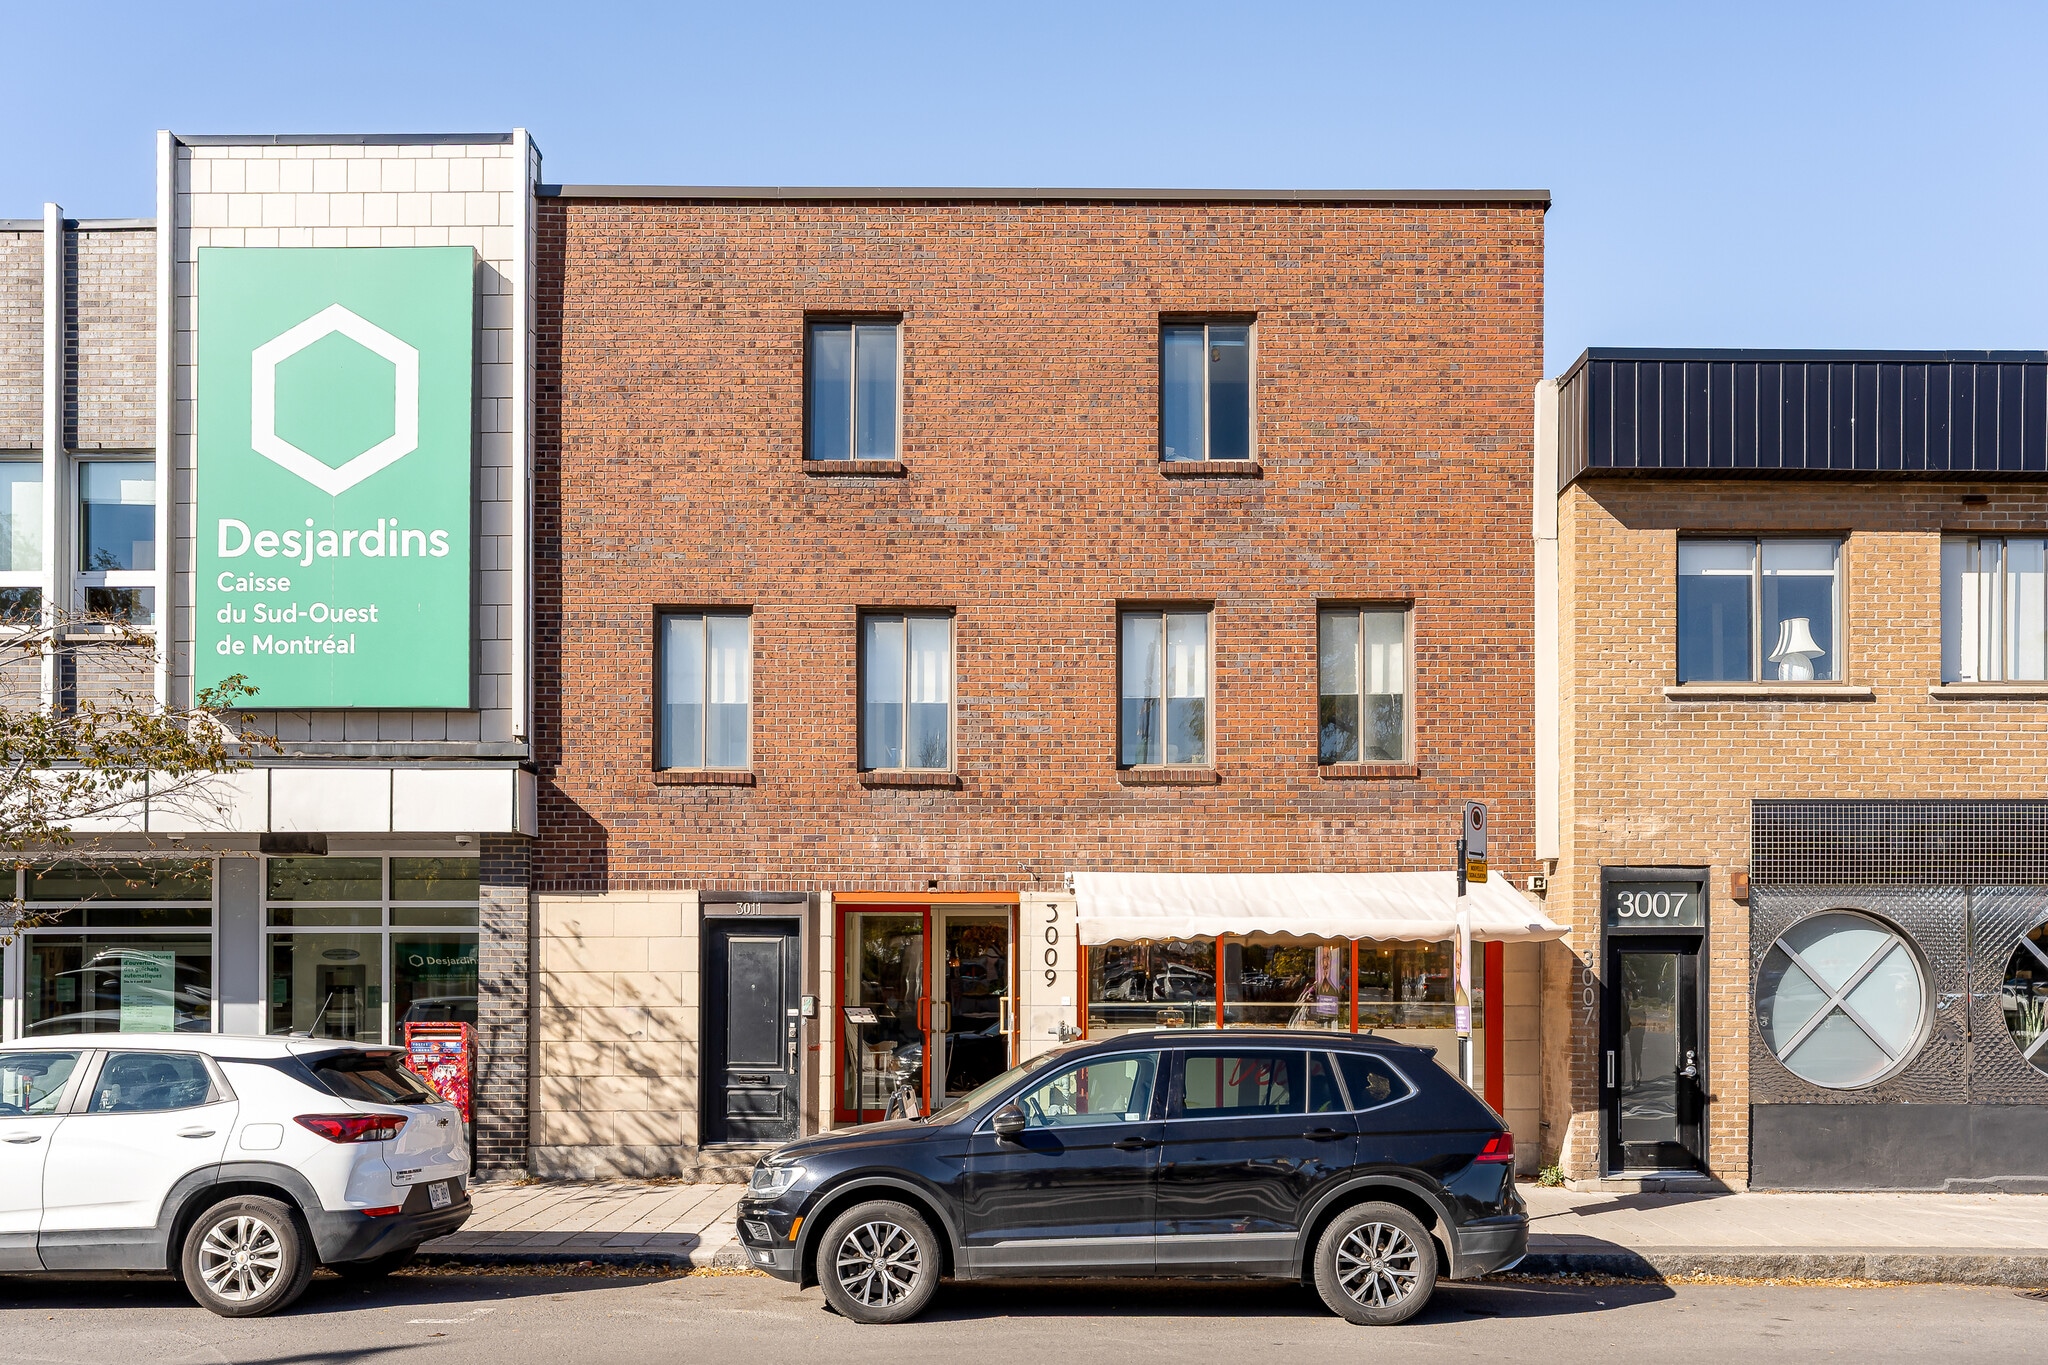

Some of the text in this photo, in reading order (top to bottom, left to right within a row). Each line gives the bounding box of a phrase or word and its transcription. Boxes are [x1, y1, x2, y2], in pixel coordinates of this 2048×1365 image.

[217, 517, 450, 567] Desjardins
[217, 571, 291, 592] Caisse
[216, 602, 379, 623] du Sud-Ouest
[215, 633, 355, 655] de Montréal
[736, 902, 761, 915] 3011
[1617, 890, 1688, 918] 3007
[1044, 903, 1059, 988] 3009
[426, 956, 479, 967] Desjardin
[1582, 949, 1594, 1025] 3007
[244, 1203, 279, 1222] Continental
